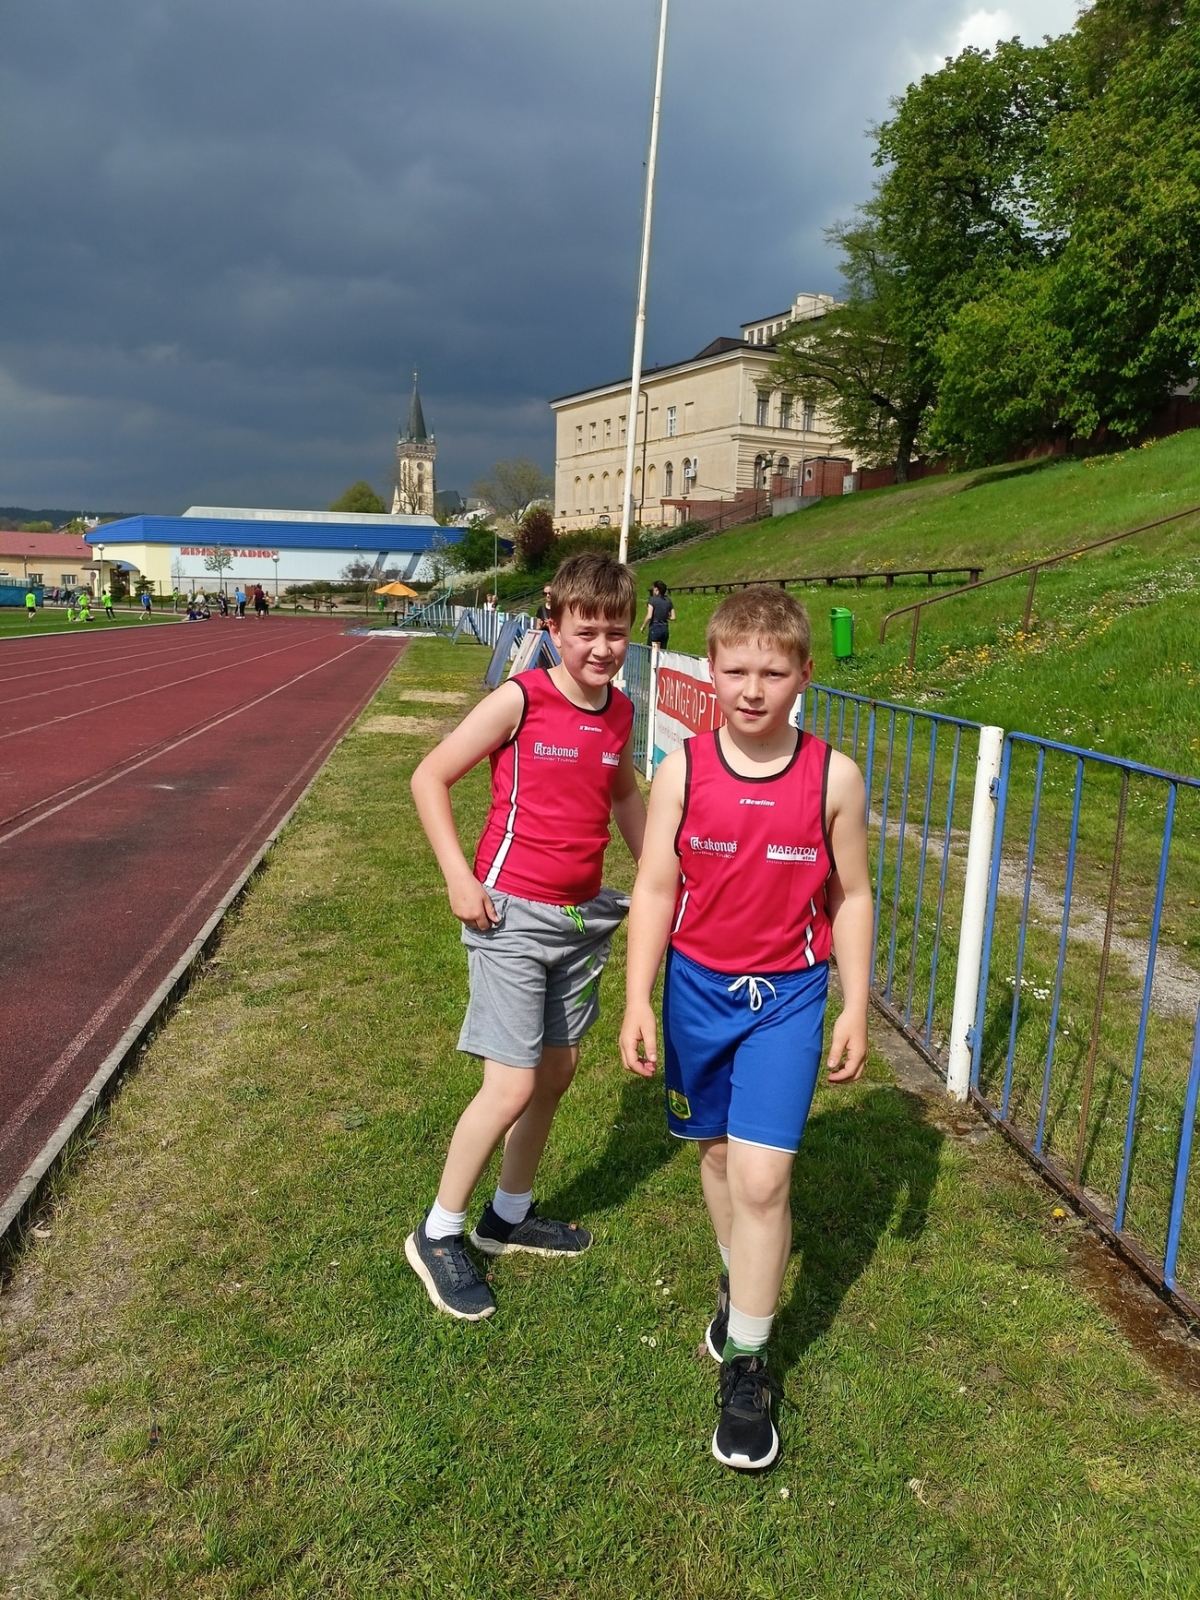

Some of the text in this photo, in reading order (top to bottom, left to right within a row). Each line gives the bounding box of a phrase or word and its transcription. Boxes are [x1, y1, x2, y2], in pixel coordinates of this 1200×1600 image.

[657, 676, 692, 719] ORANGE
[534, 742, 579, 758] Krakonoš
[690, 836, 738, 853] Krakonoš
[767, 844, 818, 855] MARATON
